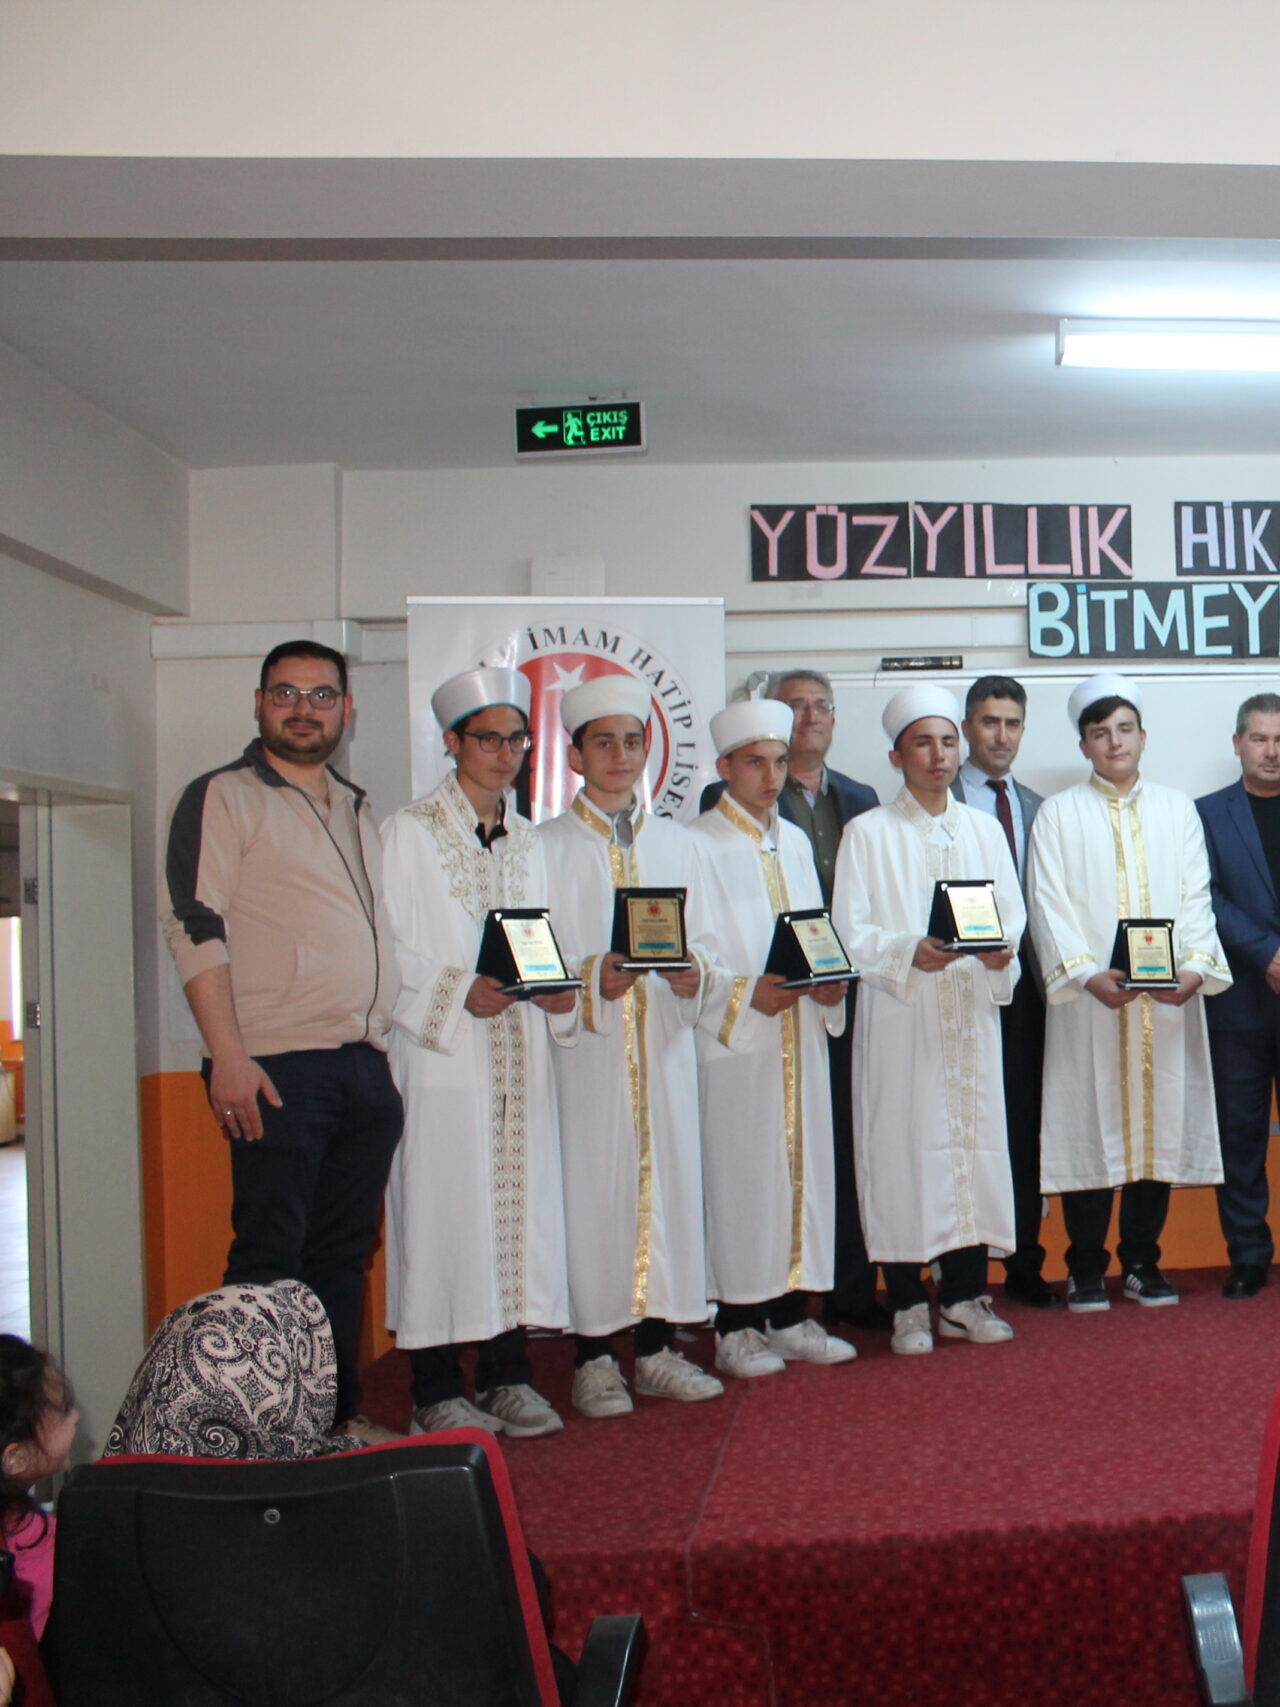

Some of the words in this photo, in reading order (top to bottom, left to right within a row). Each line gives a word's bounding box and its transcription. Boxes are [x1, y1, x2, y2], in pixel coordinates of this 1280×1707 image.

[586, 410, 628, 427] ÇIKIŞ
[590, 426, 626, 441] EXIT
[526, 625, 622, 655] İMAM
[629, 647, 696, 730] HATİP
